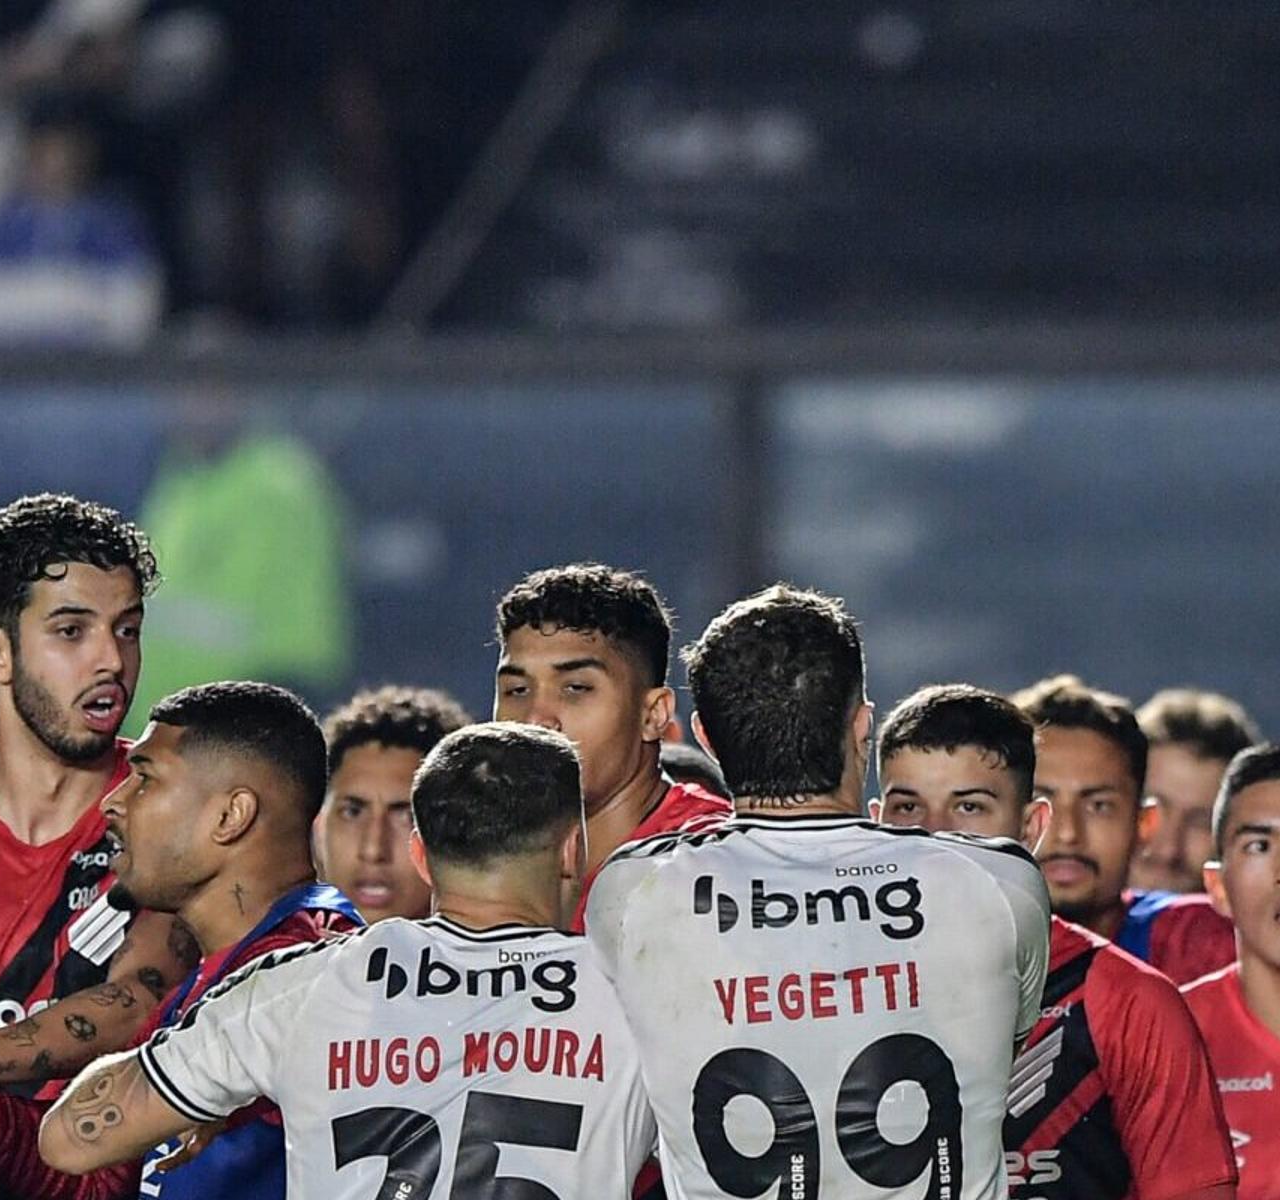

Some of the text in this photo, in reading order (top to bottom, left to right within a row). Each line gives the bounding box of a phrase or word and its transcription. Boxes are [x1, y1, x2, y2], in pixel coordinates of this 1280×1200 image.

[835, 862, 899, 878] banco
[751, 876, 925, 941] bmg
[416, 946, 578, 1013] bmg
[713, 961, 920, 1025] VEGETTI
[328, 1027, 605, 1091] HUGO MOURA
[790, 1154, 805, 1200] SCORE
[936, 1137, 952, 1185] SCORE
